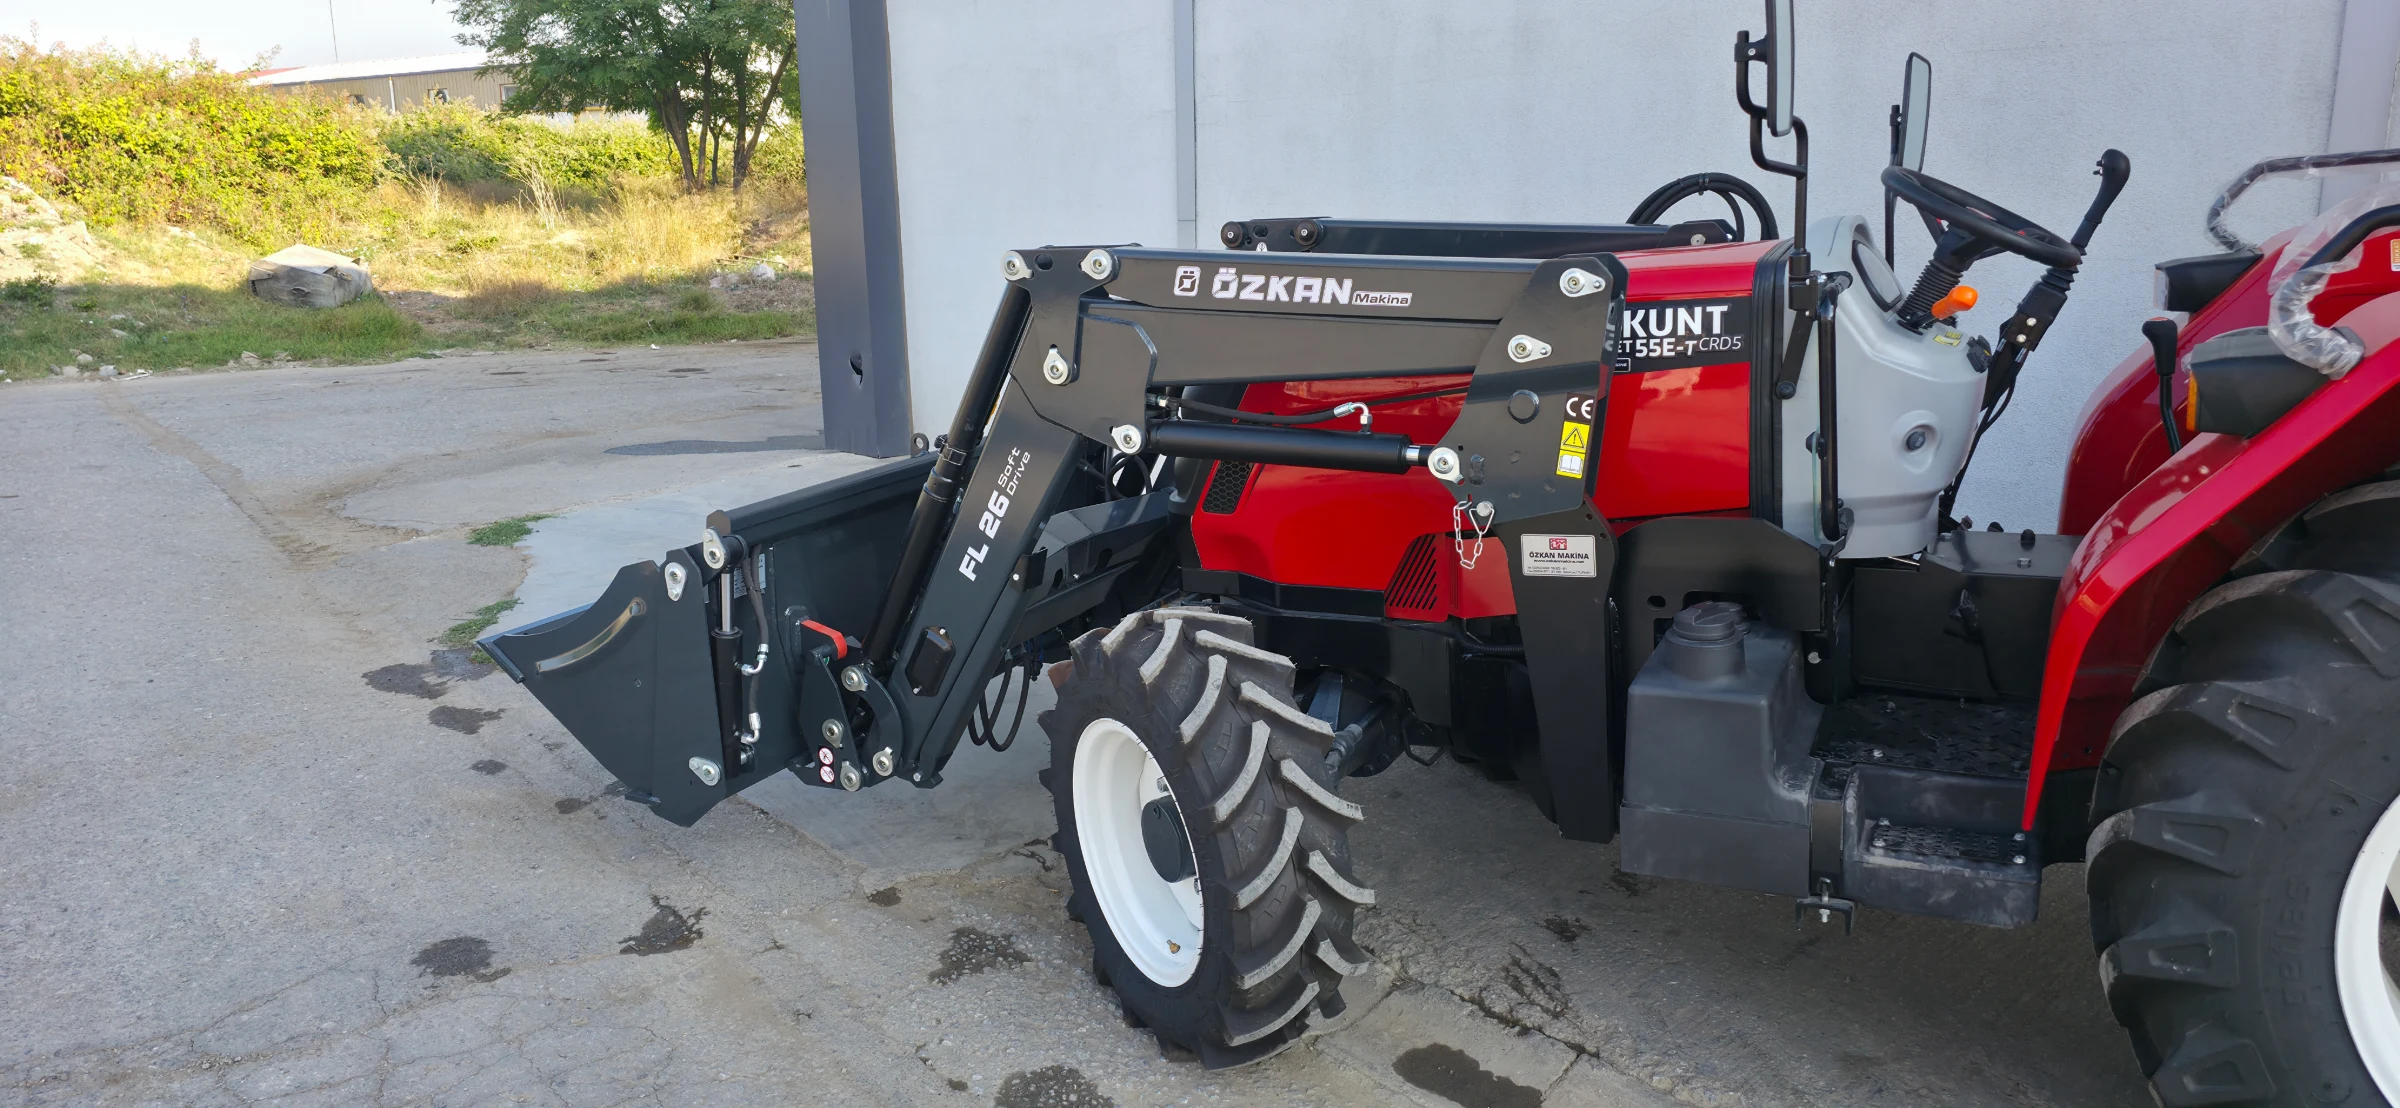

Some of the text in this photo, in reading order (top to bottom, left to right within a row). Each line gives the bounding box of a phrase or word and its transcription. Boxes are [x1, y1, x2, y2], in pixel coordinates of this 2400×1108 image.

[1212, 267, 1353, 305] ÖZKAN
[1354, 292, 1410, 307] Makina
[1623, 305, 1728, 338] KUNT
[1699, 336, 1742, 351] CRD5
[1566, 397, 1594, 419] CE
[997, 446, 1021, 488] Soft
[1006, 451, 1031, 497] Drive
[958, 490, 1010, 583] FL 26
[1529, 551, 1556, 560] ÖZKAN
